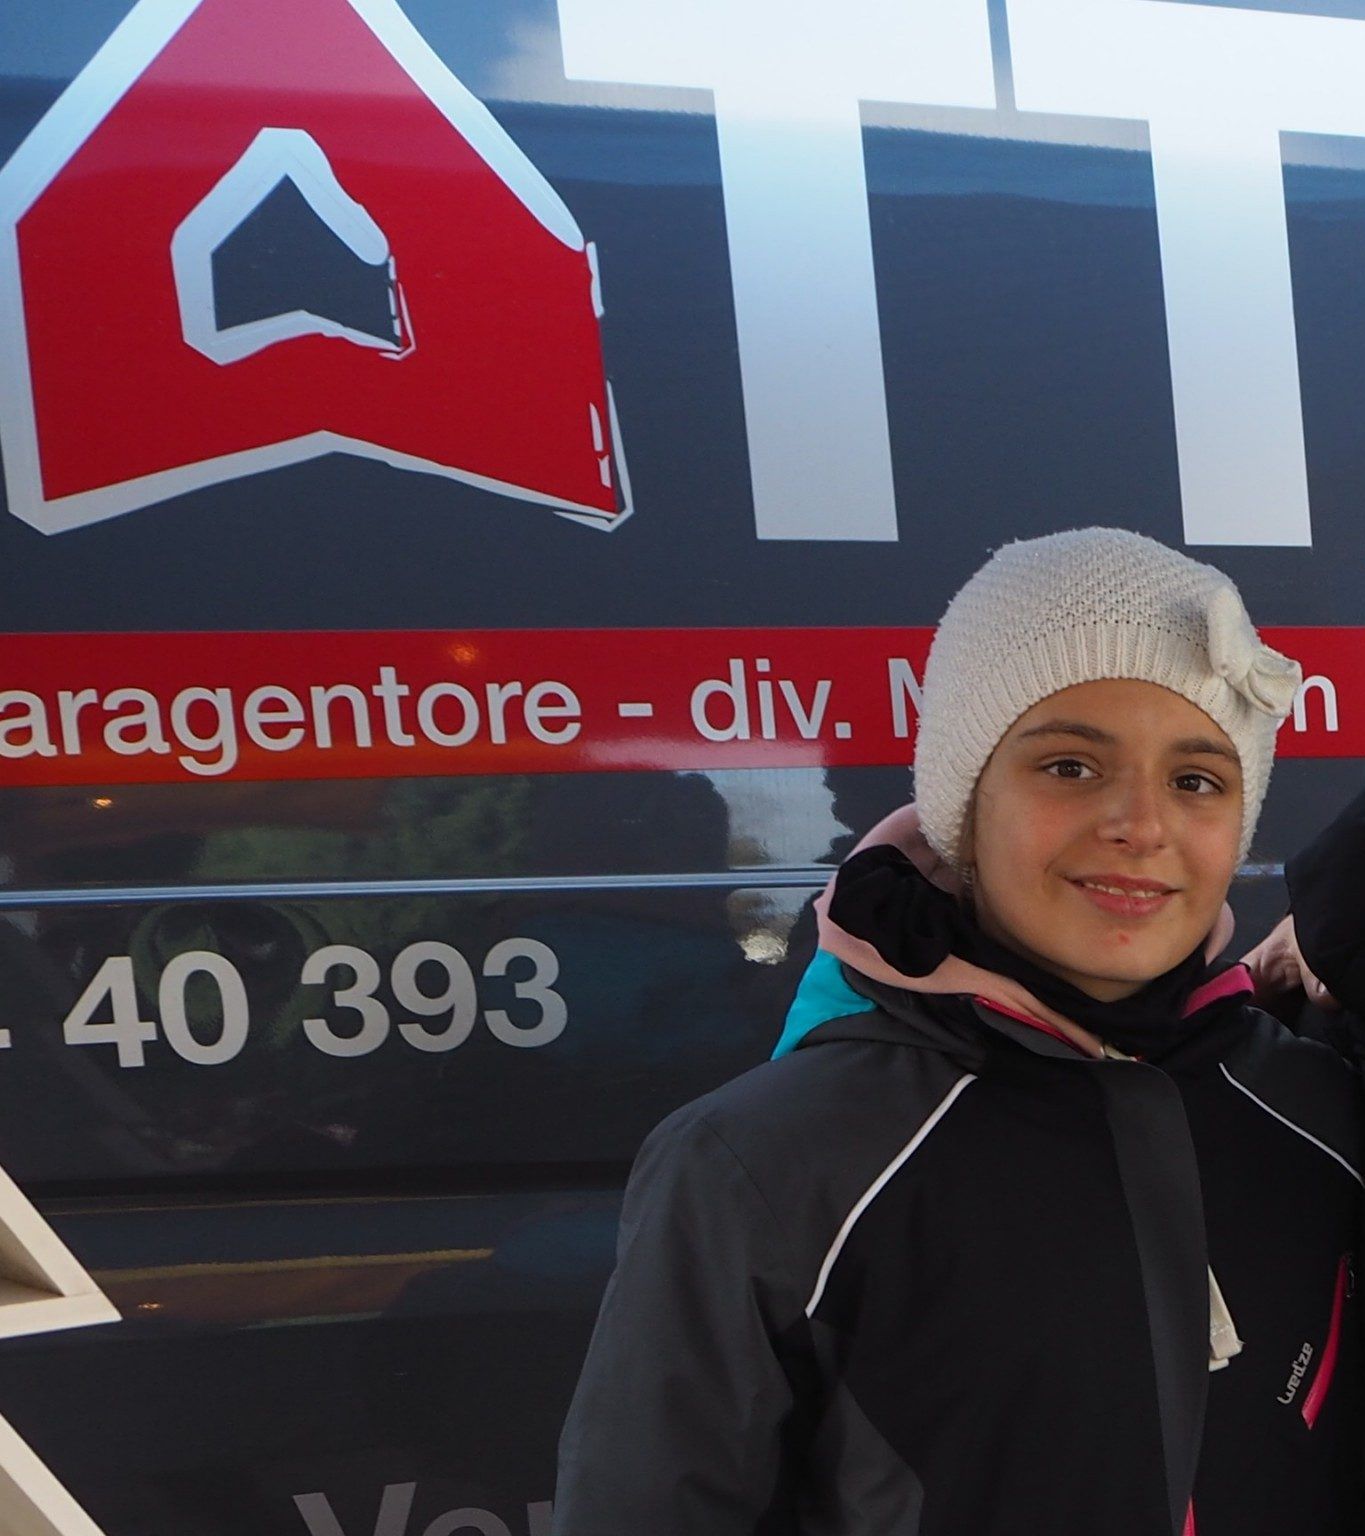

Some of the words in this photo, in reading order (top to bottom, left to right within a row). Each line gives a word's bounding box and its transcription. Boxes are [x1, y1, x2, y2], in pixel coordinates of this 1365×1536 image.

[0, 666, 582, 776] aragentore
[690, 658, 852, 742] div.
[63, 949, 250, 1068] 40
[301, 938, 568, 1058] 393
